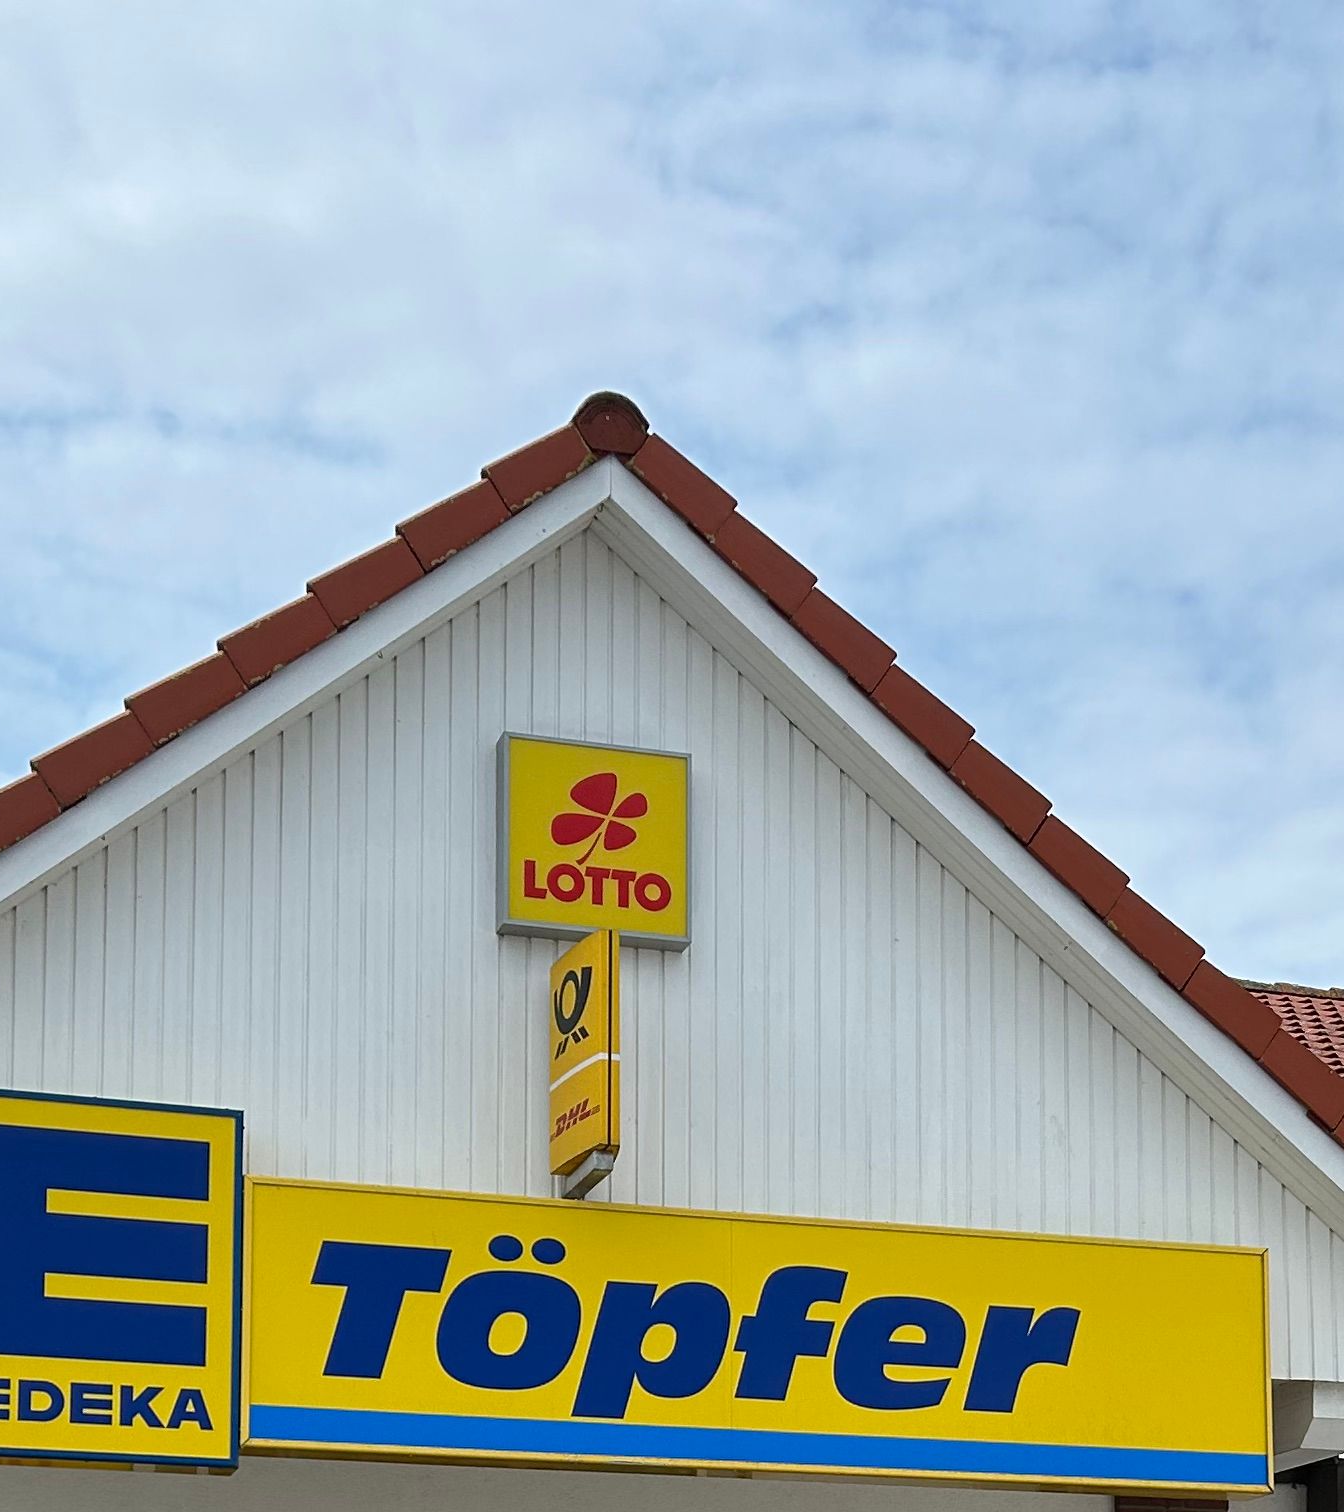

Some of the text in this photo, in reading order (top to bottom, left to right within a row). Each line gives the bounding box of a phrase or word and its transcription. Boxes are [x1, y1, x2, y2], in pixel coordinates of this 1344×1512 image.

[523, 858, 673, 912] LOTTO
[554, 1097, 592, 1136] DHL
[310, 1234, 1081, 1419] Töpfer
